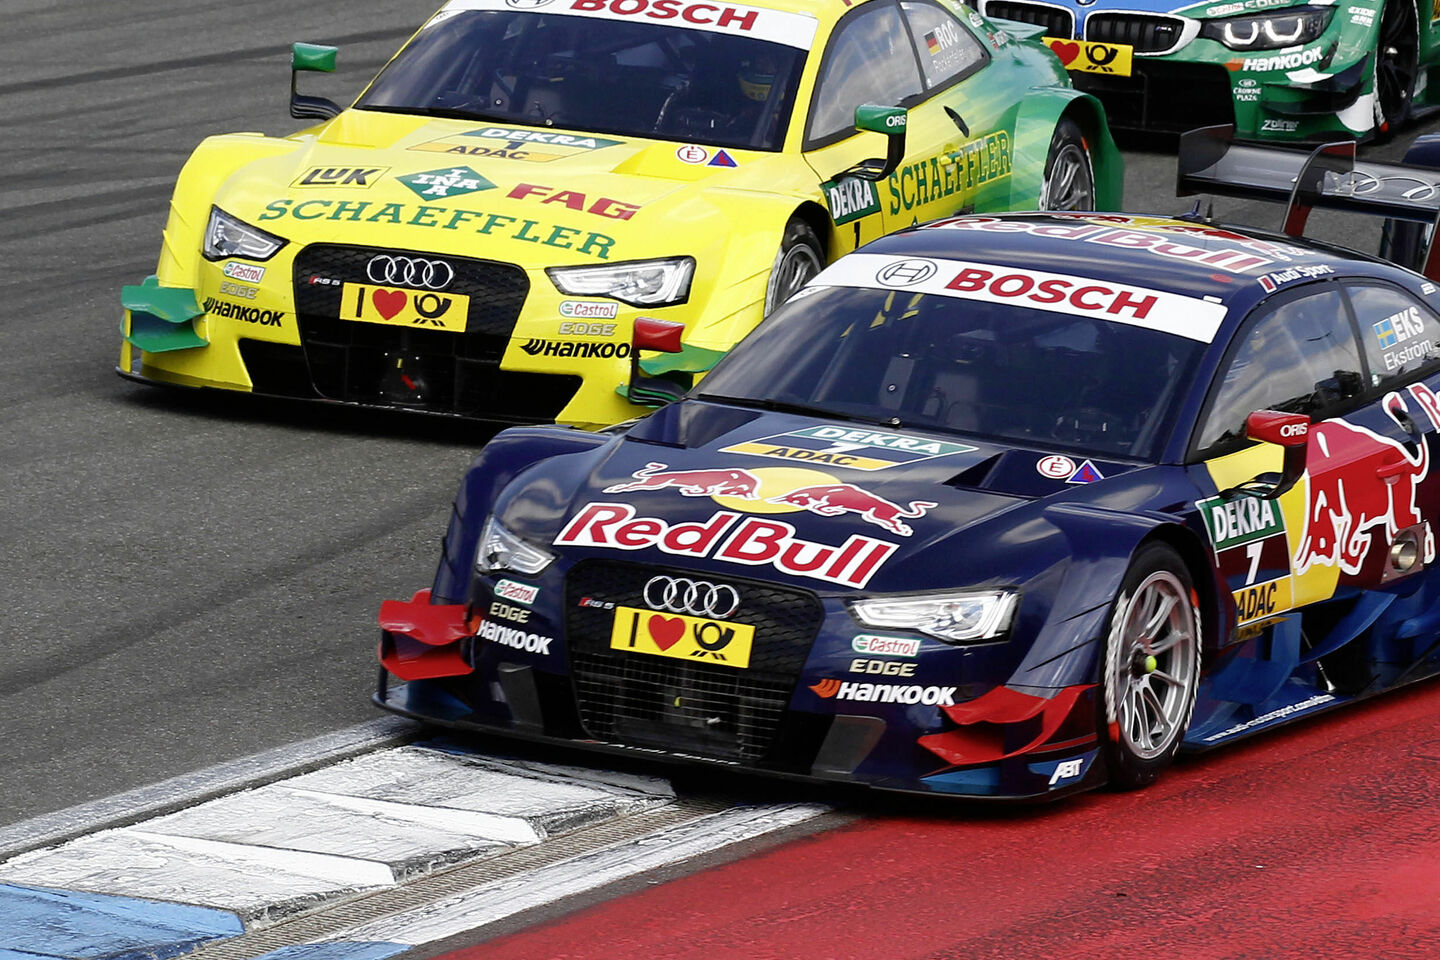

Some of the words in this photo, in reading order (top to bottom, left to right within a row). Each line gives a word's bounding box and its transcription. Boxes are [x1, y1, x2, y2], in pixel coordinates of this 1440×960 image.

[935, 19, 959, 51] ROC
[1233, 87, 1262, 95] CROWNE
[886, 115, 907, 128] ORIS
[449, 144, 530, 161] ADAC
[481, 127, 597, 151] DEKRA
[888, 134, 1013, 216] SCHAEFFLER
[506, 183, 643, 222] FAG
[830, 178, 875, 220] DEKRA
[257, 198, 617, 260] SCHAEFFLER
[853, 221, 861, 249] 1
[926, 216, 1098, 242] Red
[1094, 227, 1275, 273] Bull
[231, 264, 263, 281] Castrol
[1272, 268, 1298, 284] Audi
[1298, 262, 1333, 278] Sport
[219, 281, 260, 299] EDGE
[944, 267, 1159, 320] BOSCH
[574, 303, 614, 317] Castrol
[1390, 306, 1425, 342] EKS
[558, 322, 617, 337] EDGE
[1383, 340, 1432, 371] Ekström
[823, 426, 942, 455] DEKRA
[1280, 422, 1308, 437] ORIS
[764, 446, 859, 467] ADAC
[1211, 497, 1276, 543] DEKRA
[552, 502, 737, 558] Red
[712, 516, 900, 590] Bull
[1245, 540, 1264, 586] 7
[506, 582, 538, 604] Castrol
[1237, 581, 1277, 621] ADAC
[489, 602, 532, 624] EDGE
[629, 612, 640, 648] I
[868, 637, 918, 656] Castrol
[848, 658, 918, 677] EDGE
[1047, 757, 1084, 786] ABT
